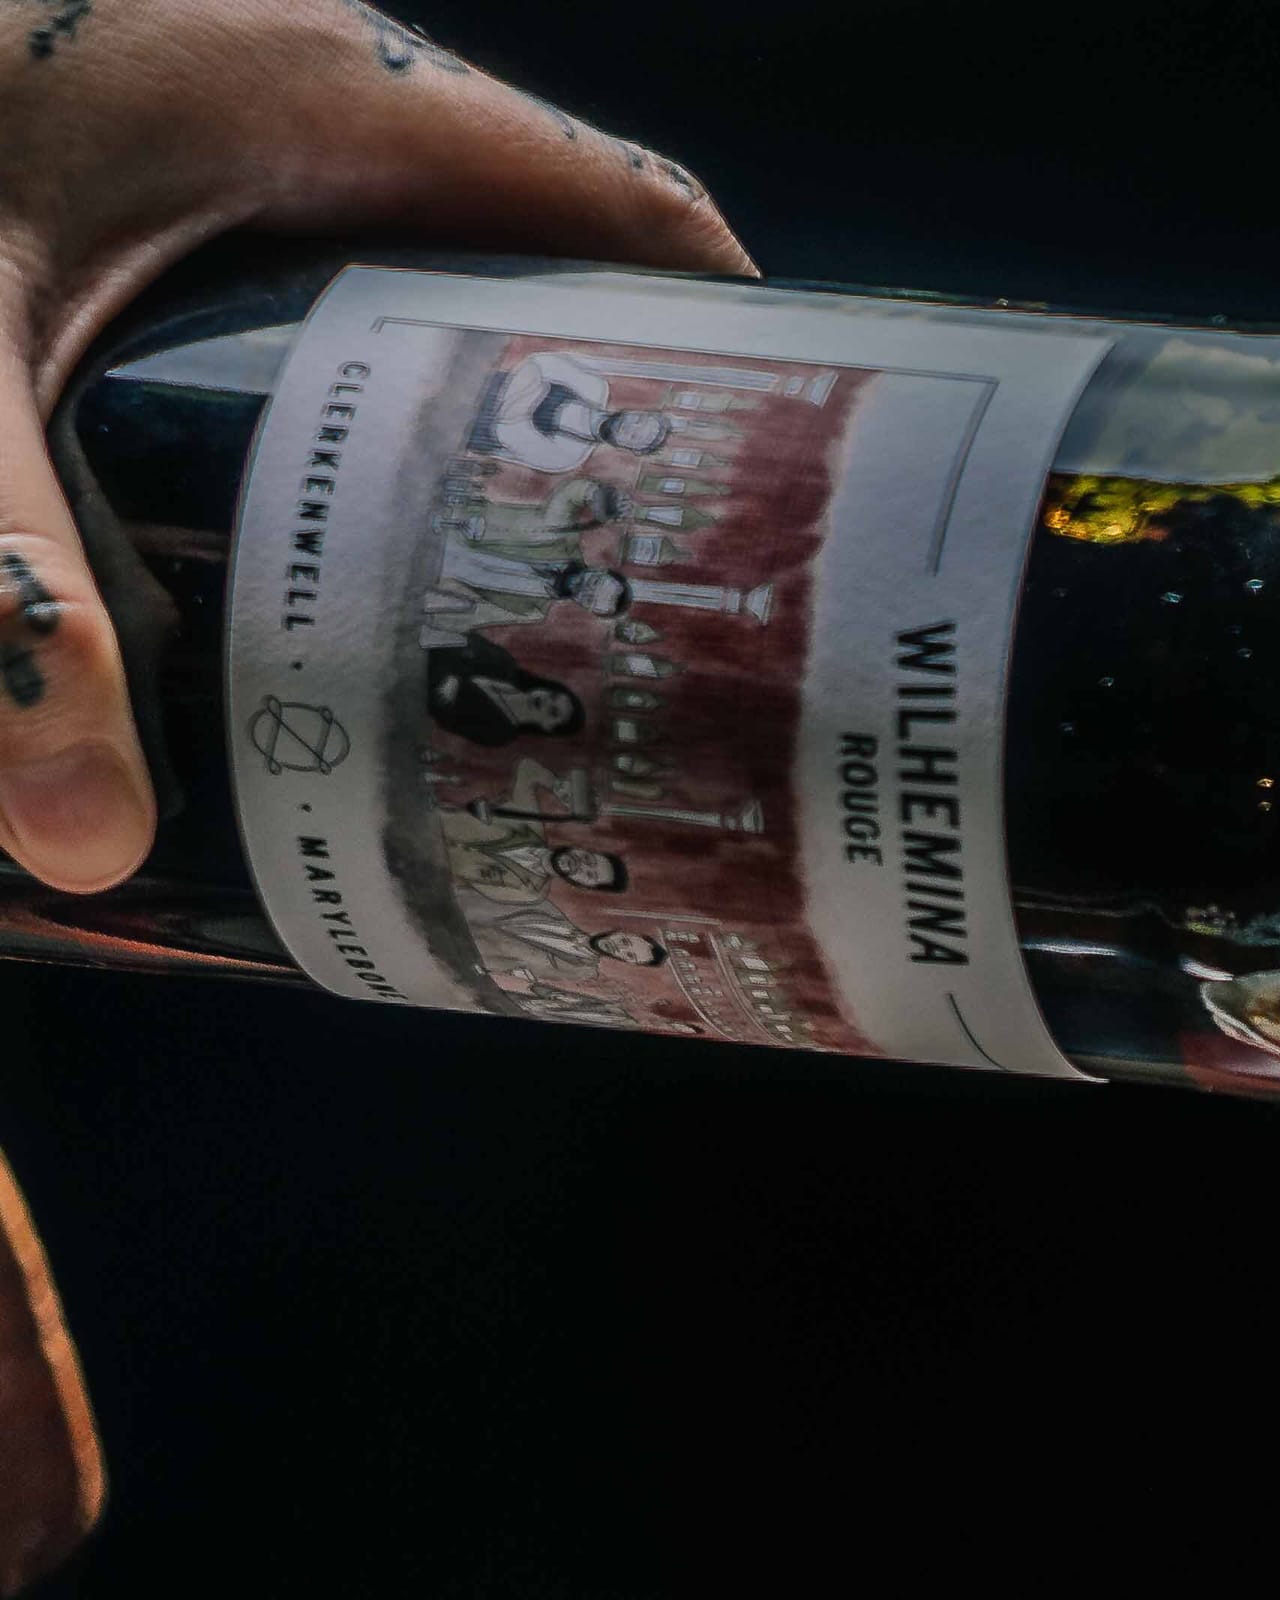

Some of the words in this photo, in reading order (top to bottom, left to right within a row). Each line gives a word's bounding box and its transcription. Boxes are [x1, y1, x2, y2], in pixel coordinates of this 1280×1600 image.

[281, 359, 372, 632] CLERKENWELL
[838, 731, 884, 868] ROUGE
[895, 618, 970, 966] WILHEMINA
[298, 832, 409, 1001] MARYLEBONE
